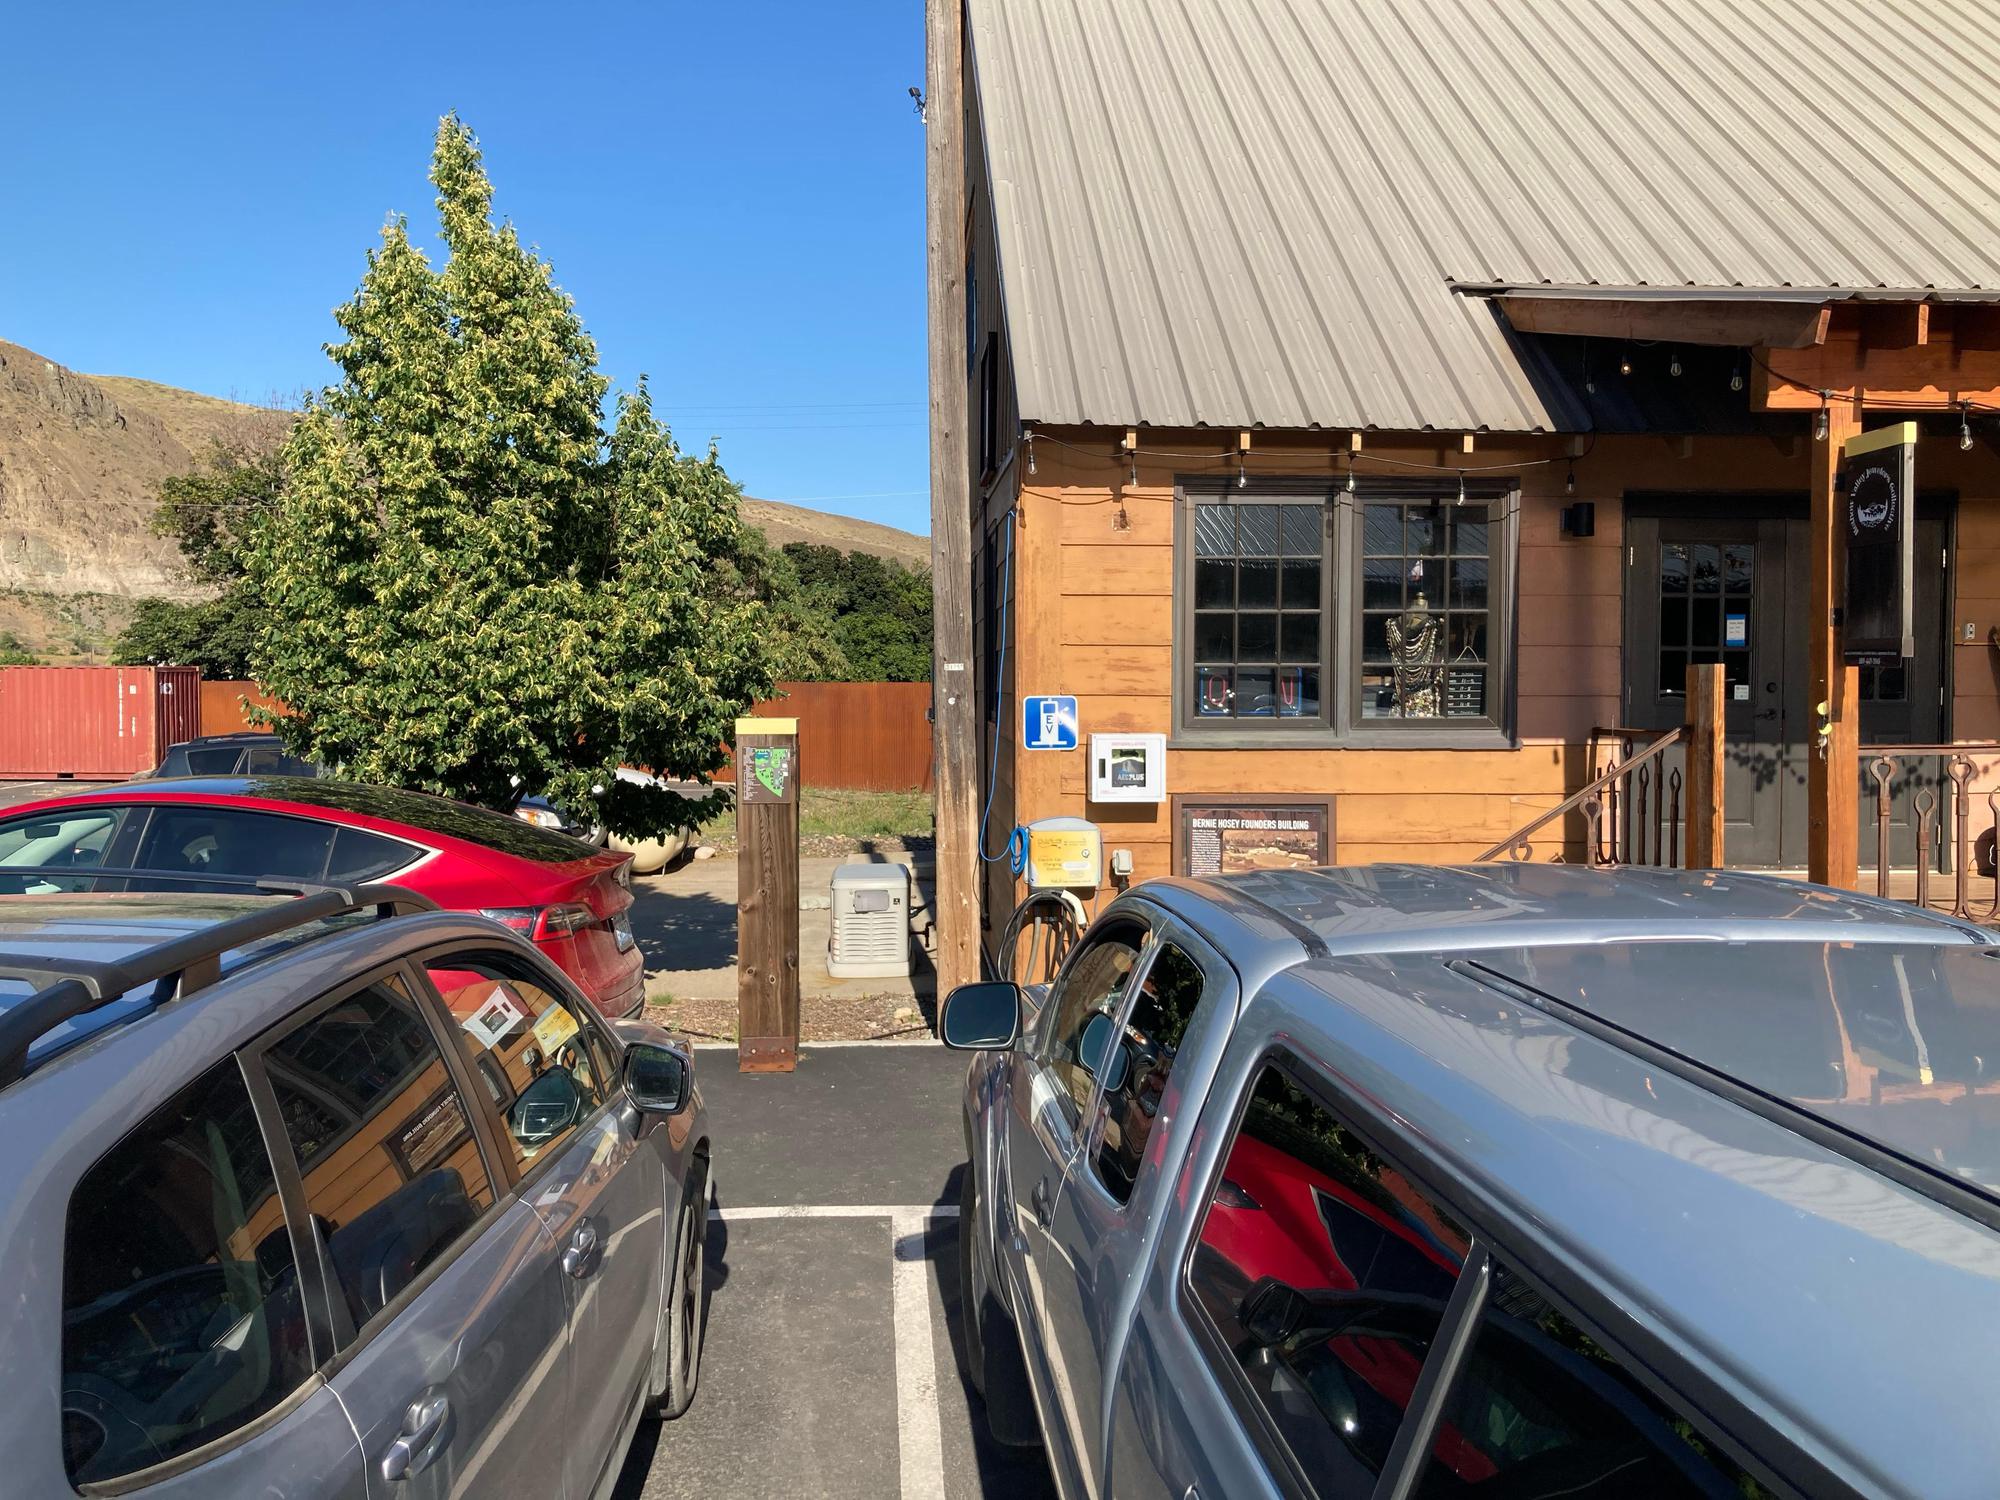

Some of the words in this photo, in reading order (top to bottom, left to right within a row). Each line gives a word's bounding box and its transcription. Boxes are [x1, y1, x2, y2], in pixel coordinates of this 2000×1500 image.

[1850, 473, 1866, 497] Valley
[1192, 818, 1217, 828] BERNIE
[1217, 819, 1240, 829] HOSEY
[1240, 819, 1277, 830] FOUNDERS
[1277, 820, 1309, 830] BUILDING
